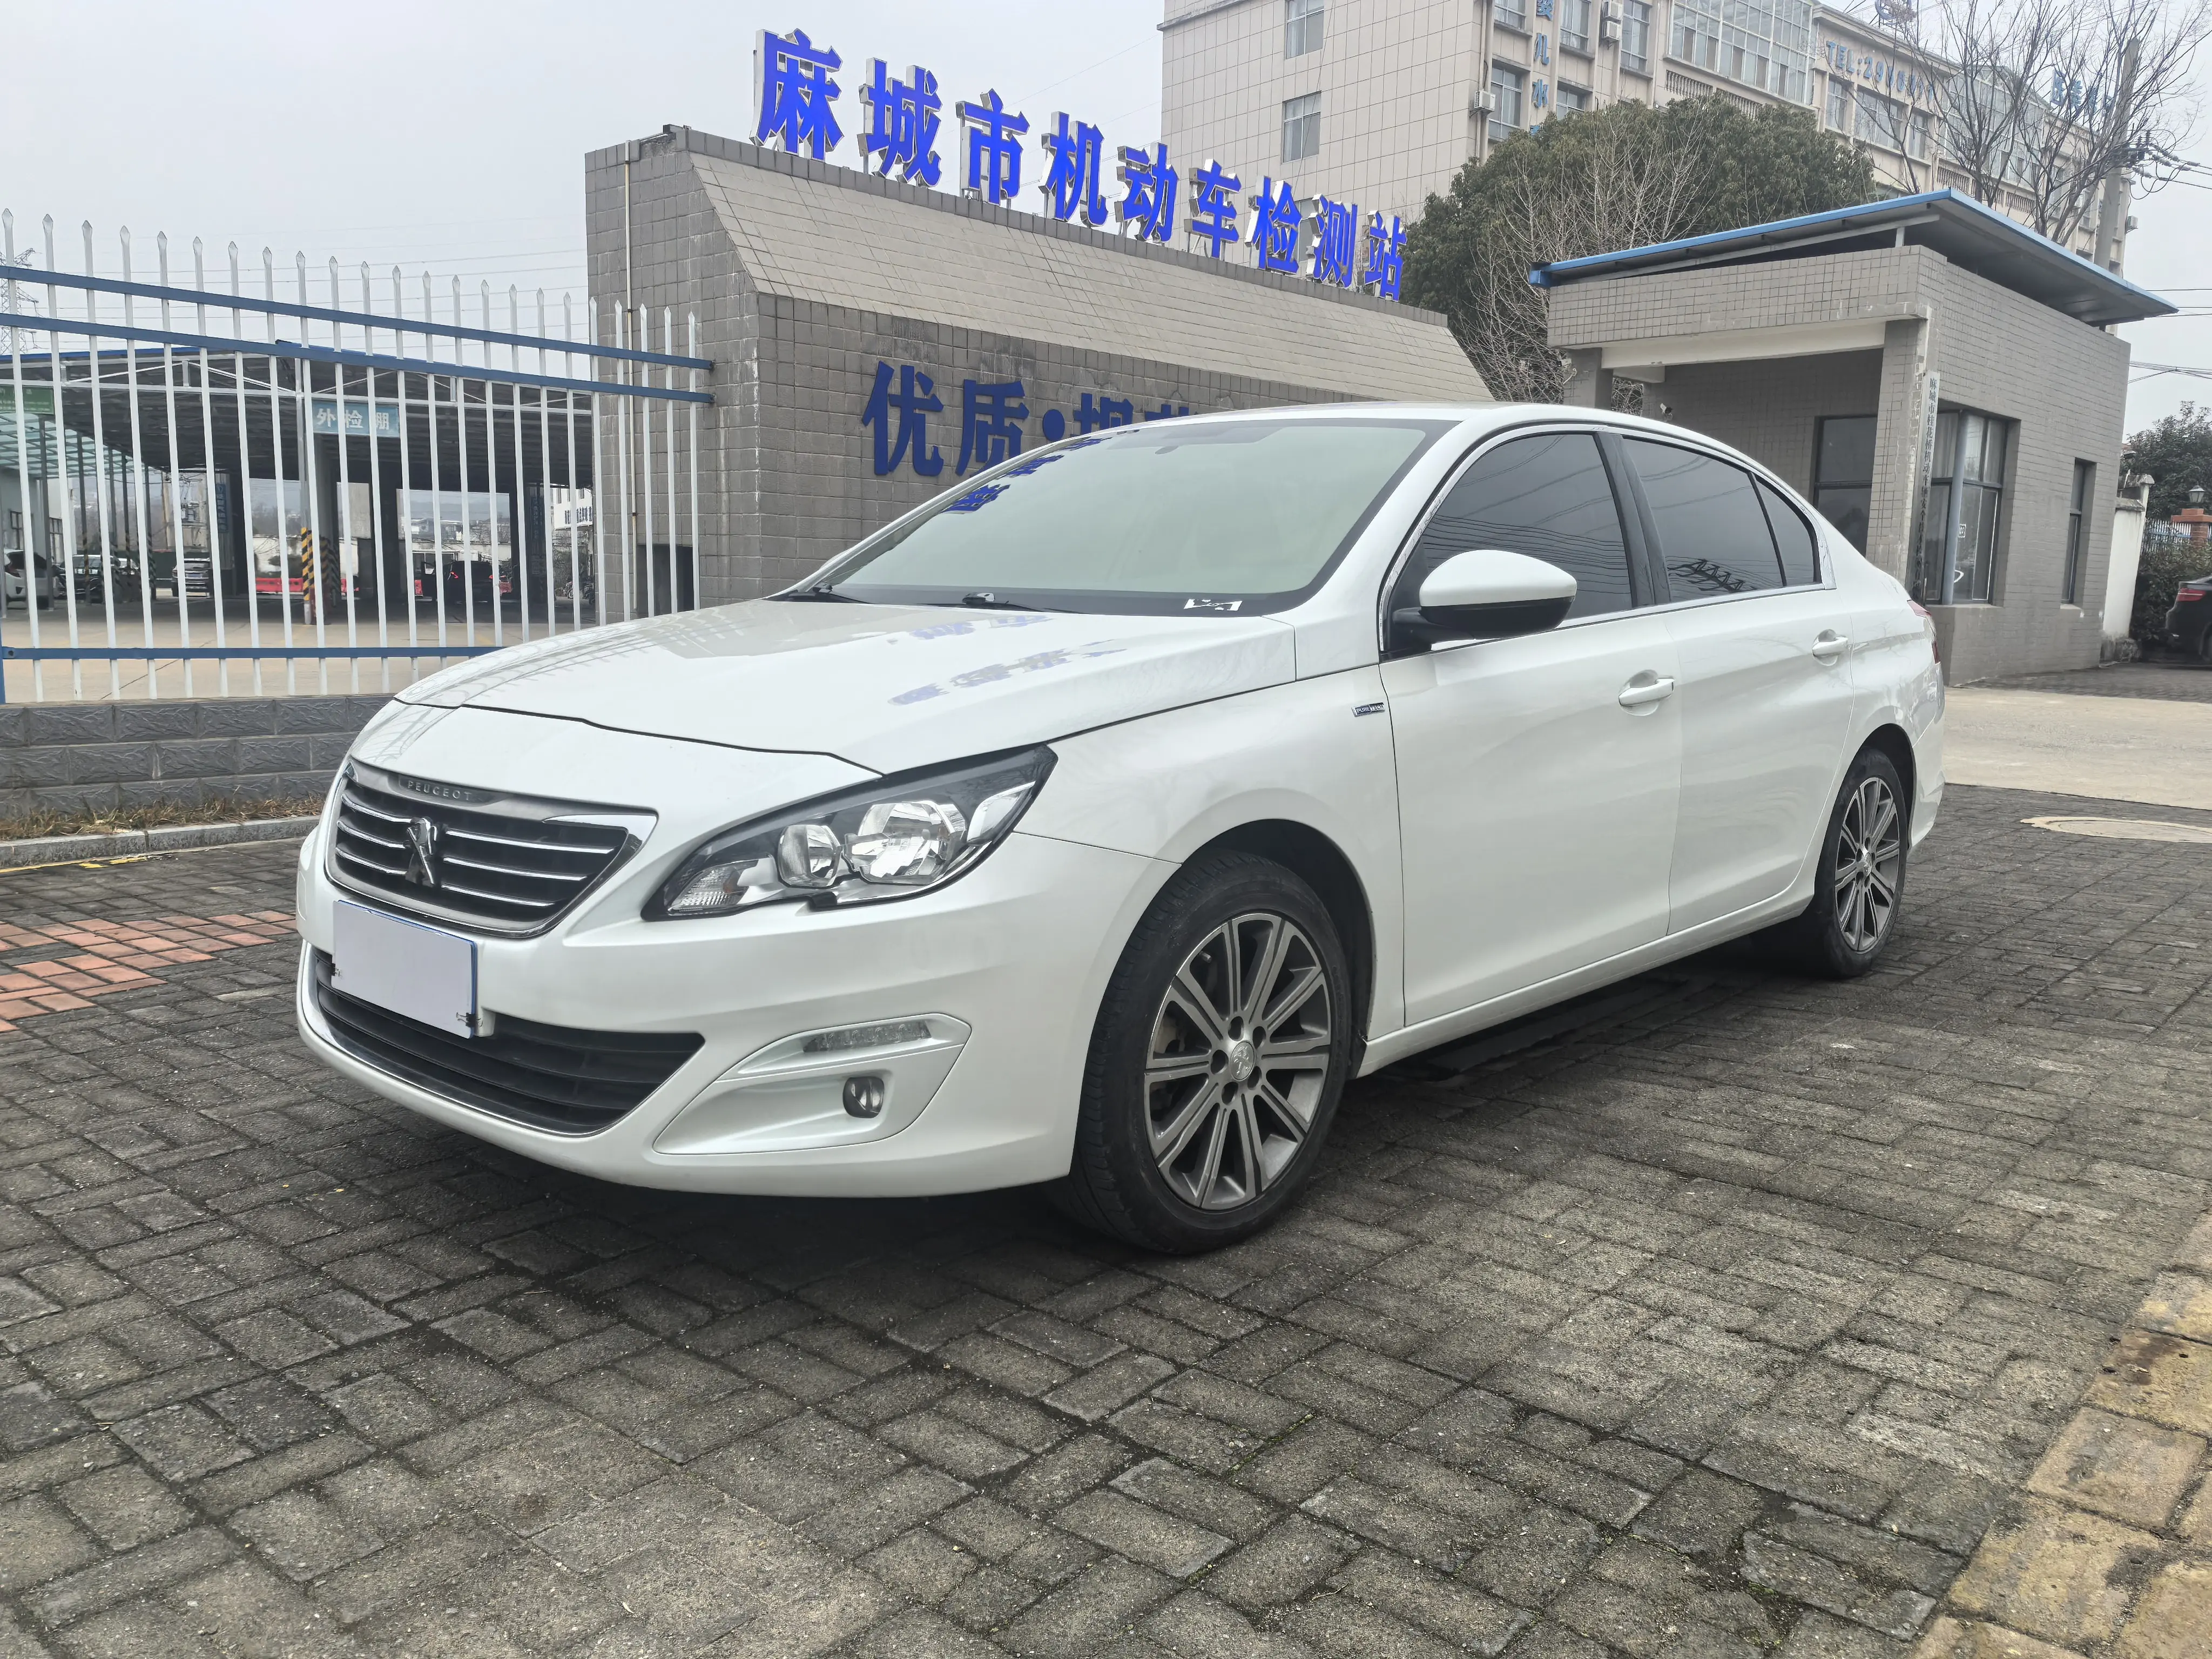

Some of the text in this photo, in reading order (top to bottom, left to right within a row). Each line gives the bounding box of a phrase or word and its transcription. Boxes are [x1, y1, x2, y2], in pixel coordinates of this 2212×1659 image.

[752, 28, 1407, 302] 麻城市机动车检测站
[408, 780, 473, 801] PEUGEOT
